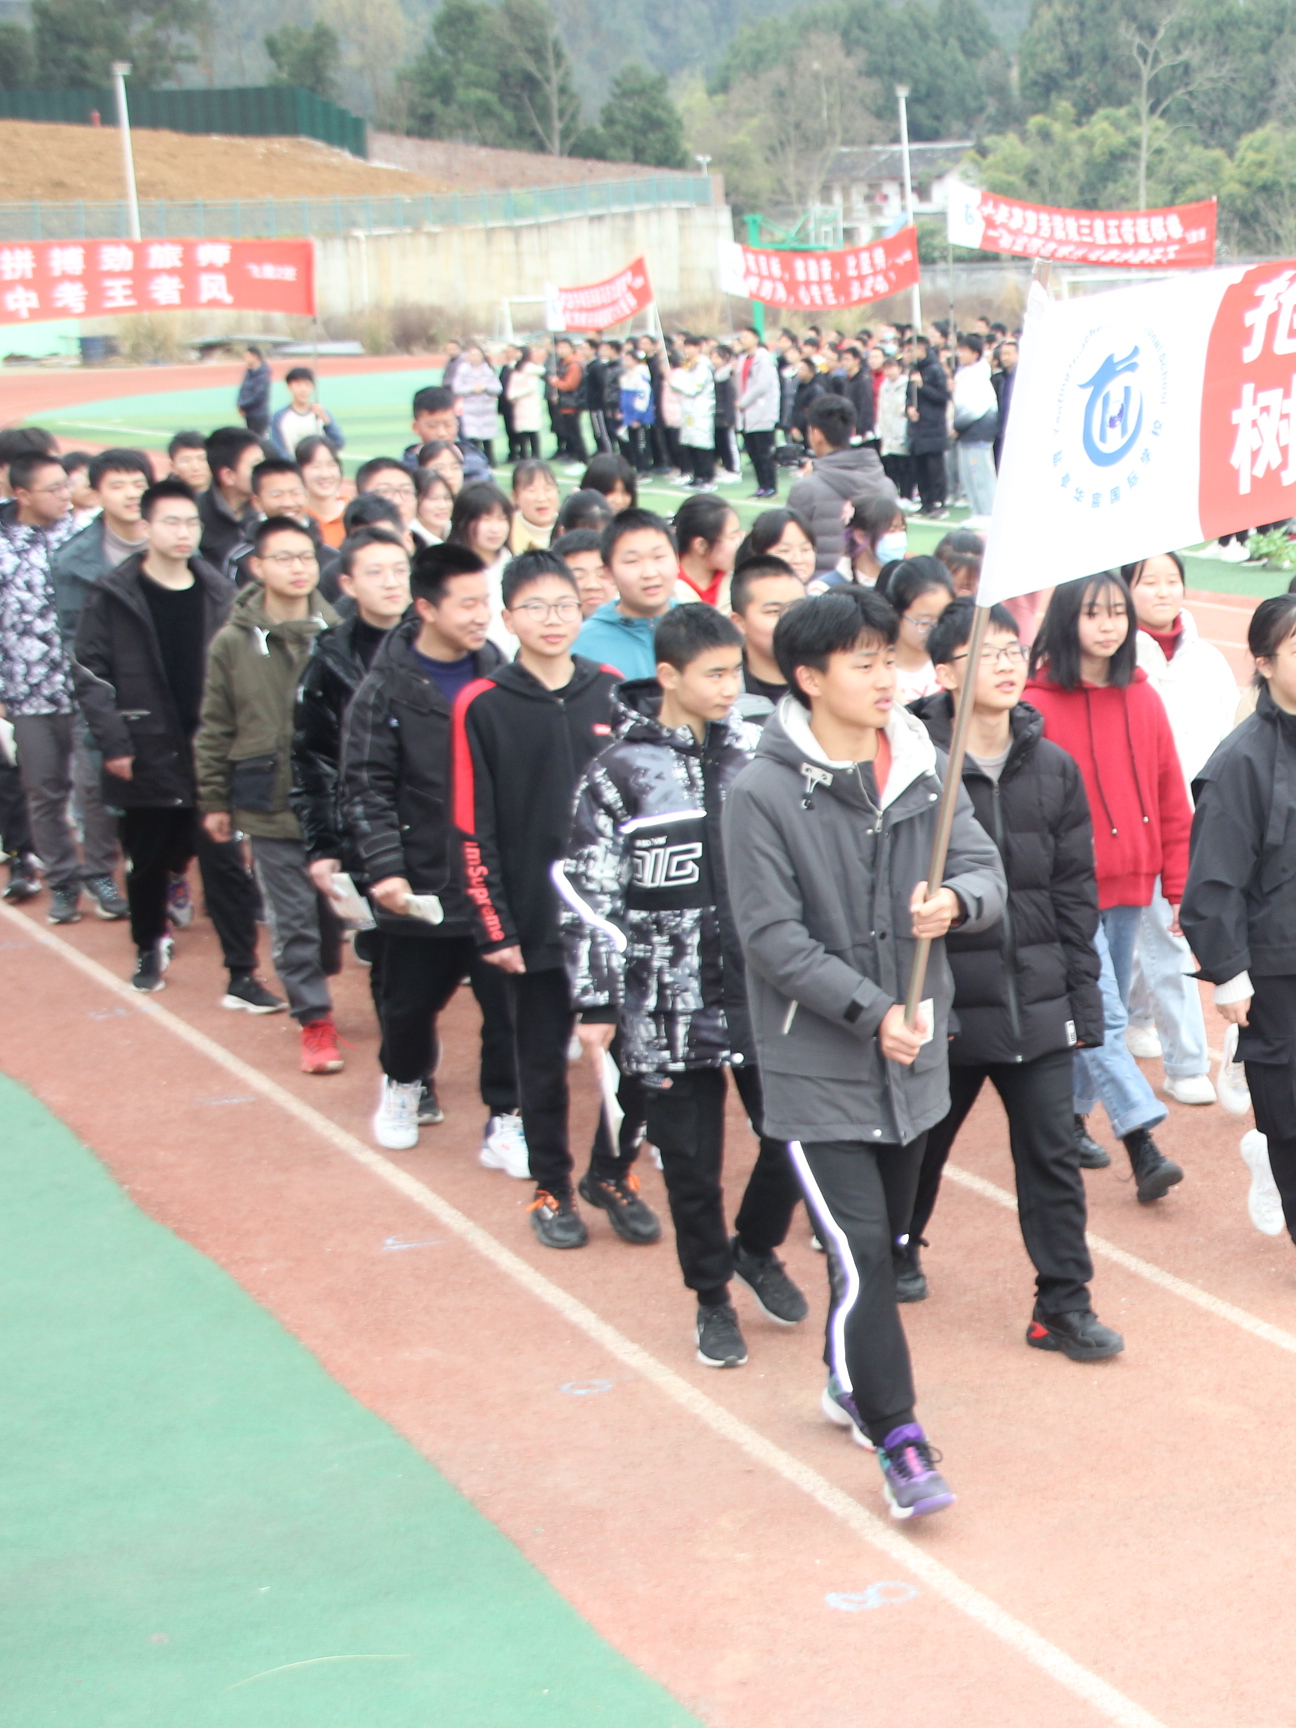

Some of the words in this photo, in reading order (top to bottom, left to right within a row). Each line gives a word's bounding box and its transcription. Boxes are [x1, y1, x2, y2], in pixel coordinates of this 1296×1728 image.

[0, 243, 232, 281] 拼搏劲旅师
[3, 272, 234, 319] 中考王者风
